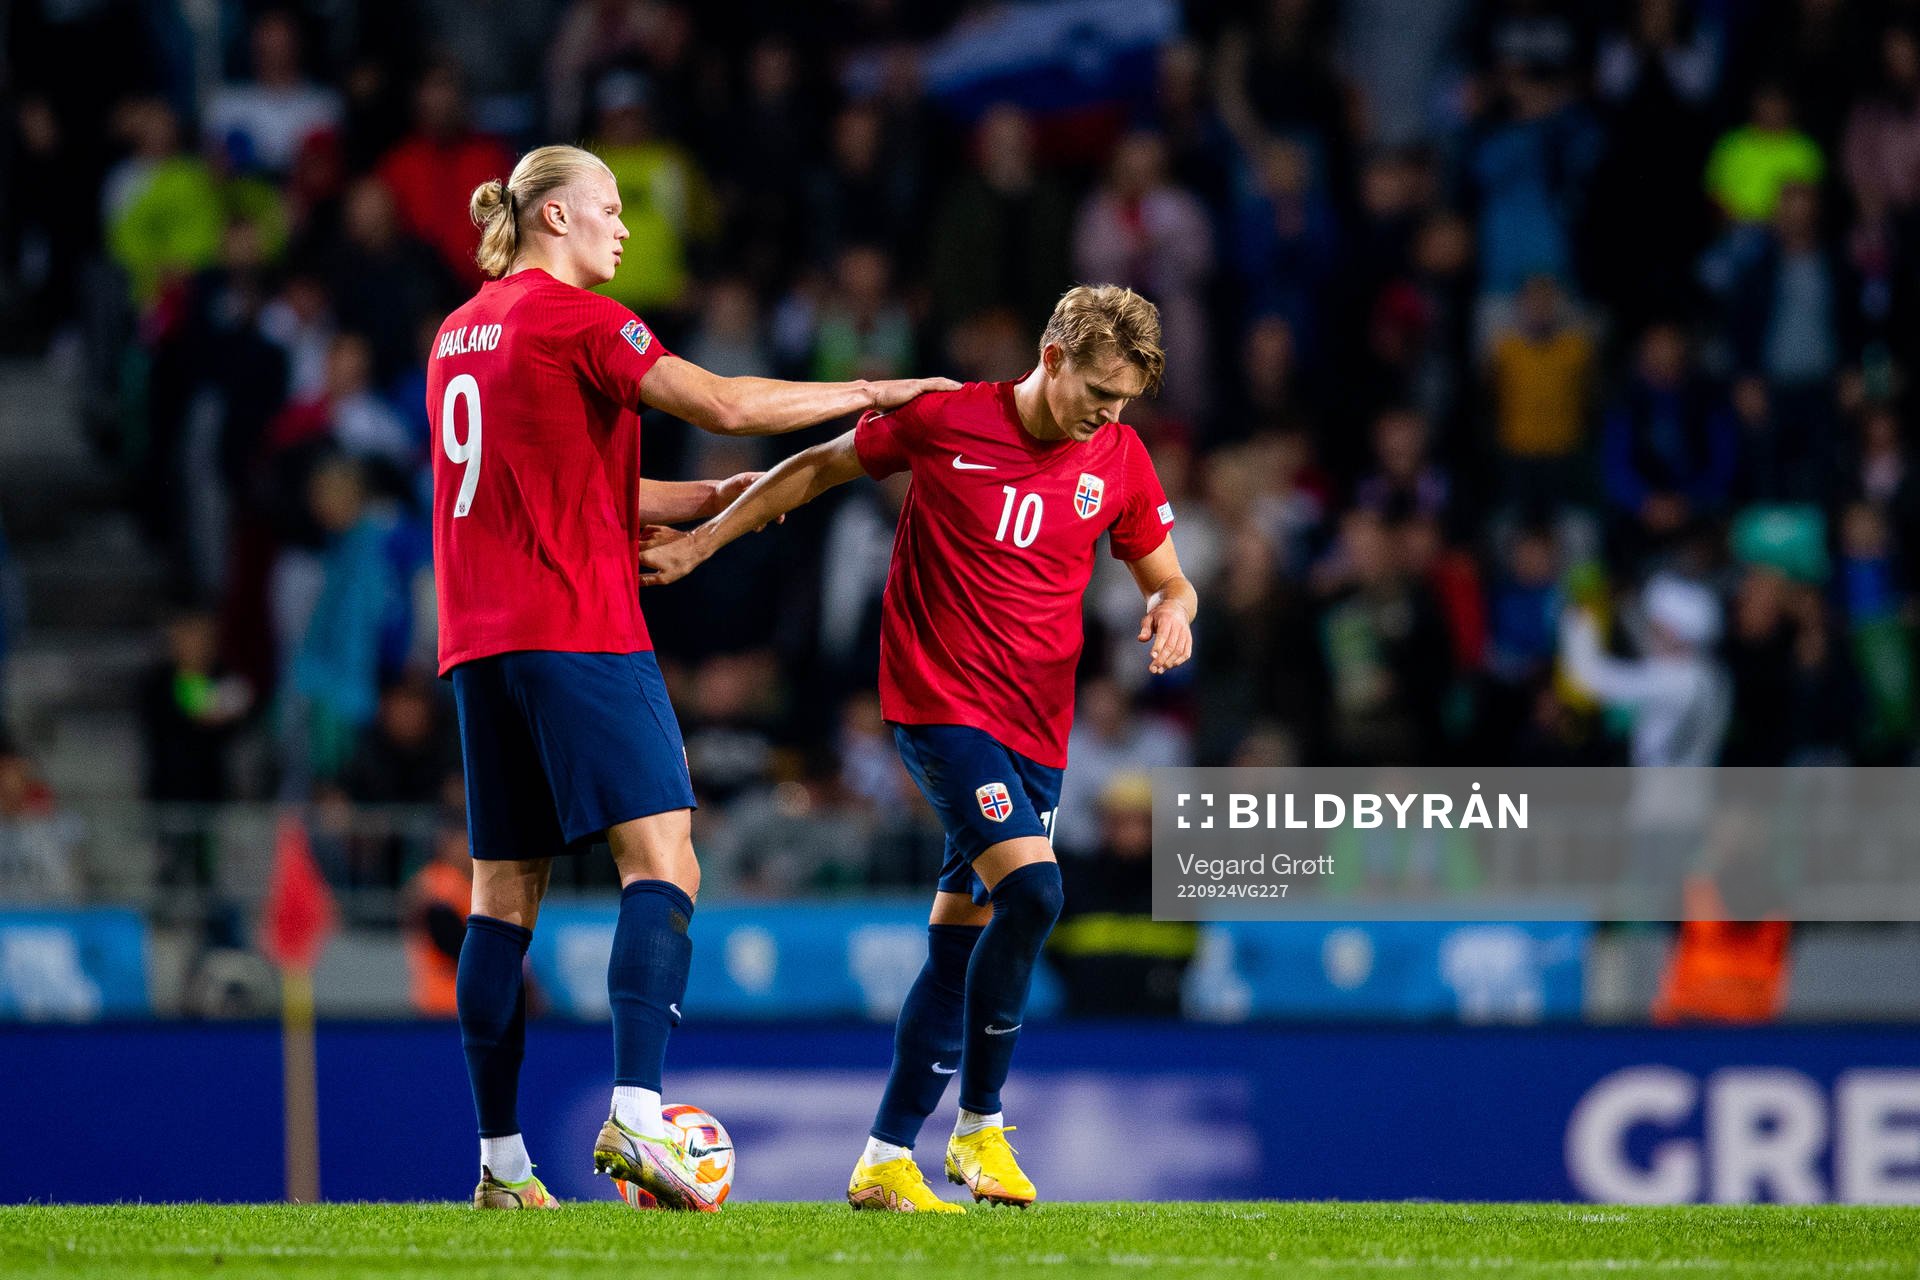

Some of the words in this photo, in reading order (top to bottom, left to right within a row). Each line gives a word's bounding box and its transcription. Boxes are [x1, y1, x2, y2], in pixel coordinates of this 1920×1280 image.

[436, 323, 503, 360] HAALAND
[442, 373, 482, 518] 9
[994, 484, 1044, 548] 10
